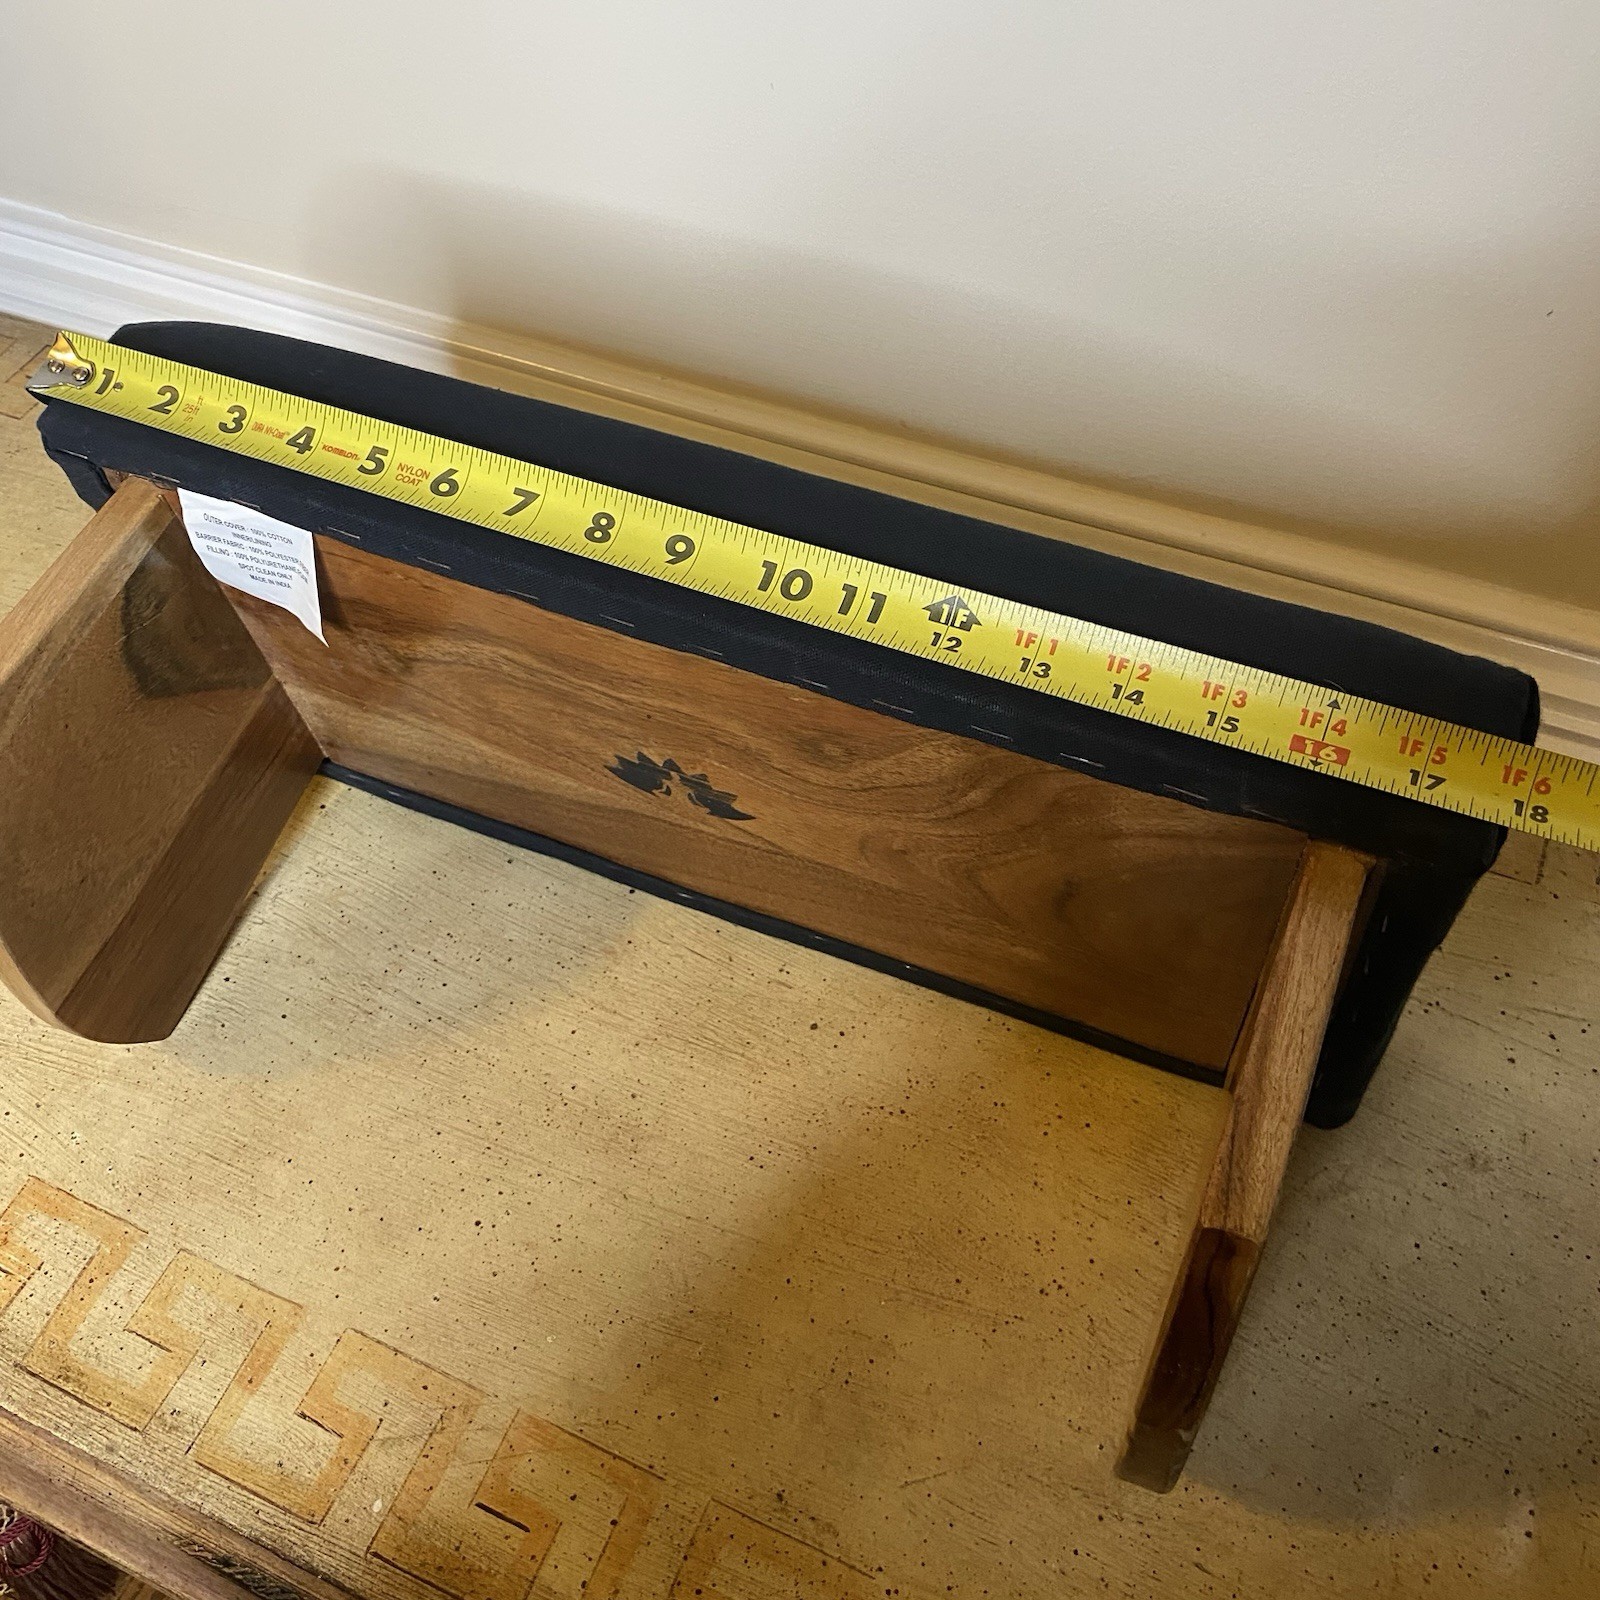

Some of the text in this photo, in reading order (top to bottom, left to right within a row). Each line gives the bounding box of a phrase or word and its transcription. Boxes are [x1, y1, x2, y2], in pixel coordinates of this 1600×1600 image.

[95, 368, 115, 394] 1
[148, 385, 180, 414] 2
[218, 405, 247, 433] 3
[286, 426, 316, 454] 4
[357, 445, 389, 475] 5
[396, 462, 430, 480] NYLON
[395, 474, 423, 486] COAT
[430, 468, 460, 497] 6
[502, 486, 541, 516] 7
[203, 512, 223, 526] OUTER
[224, 521, 246, 532] COVER
[266, 532, 293, 545] COTTON
[584, 512, 616, 544] 8
[194, 531, 222, 544] BARRIER
[222, 538, 244, 550] FABRIC
[264, 550, 299, 564] POLYESTER
[206, 544, 230, 556] FILLING
[664, 534, 696, 565] 9
[238, 562, 292, 581] SPOT CLEAN ONLY
[249, 573, 268, 584] MADE
[275, 580, 292, 590] INDIA
[757, 560, 814, 601] 10
[838, 583, 888, 624] 11
[930, 632, 962, 653] 12
[1015, 629, 1059, 656] 1F 1
[1018, 657, 1052, 678] 13
[1106, 654, 1152, 682] 1F 2
[1112, 683, 1145, 706] 14
[1201, 680, 1248, 708] 1F 3
[1205, 710, 1240, 733] 15
[1300, 708, 1348, 737] 1F 4
[1303, 739, 1338, 762] 16
[1398, 736, 1448, 765] 1F 5
[1408, 768, 1447, 790] 17
[1502, 765, 1552, 795] 1F 6
[1513, 798, 1549, 824] 18
